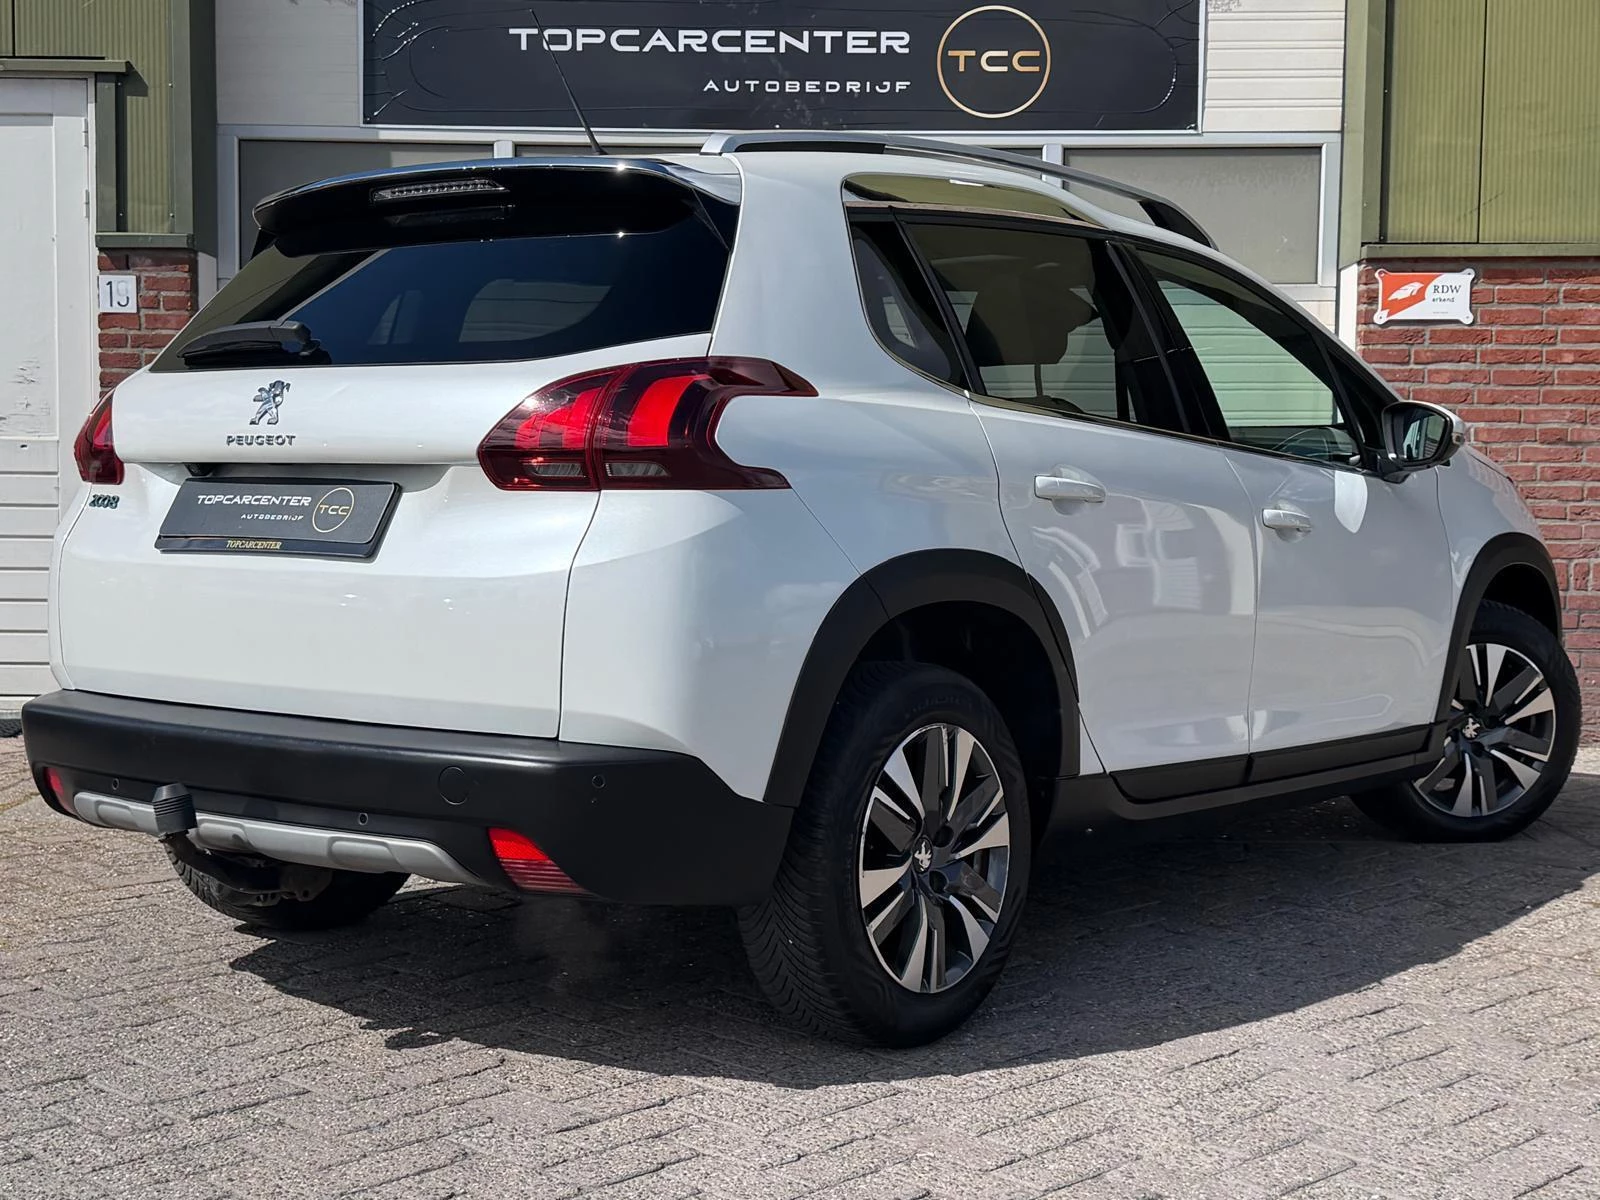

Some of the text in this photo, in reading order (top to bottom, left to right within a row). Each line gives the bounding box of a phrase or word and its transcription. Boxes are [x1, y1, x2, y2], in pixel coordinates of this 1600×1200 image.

[508, 28, 911, 54] TOPCARCENTER
[947, 50, 1041, 72] TCC
[703, 80, 911, 93] AUTOBEDRIJF
[1433, 284, 1461, 294] RDW
[226, 434, 296, 446] PEUGEOT
[88, 494, 120, 509] 2008
[197, 494, 312, 507] TOPCARCENTER
[319, 504, 350, 516] TCC
[240, 513, 304, 521] AUTOBEDRIJF
[226, 540, 283, 550] TOPCARCENTER
